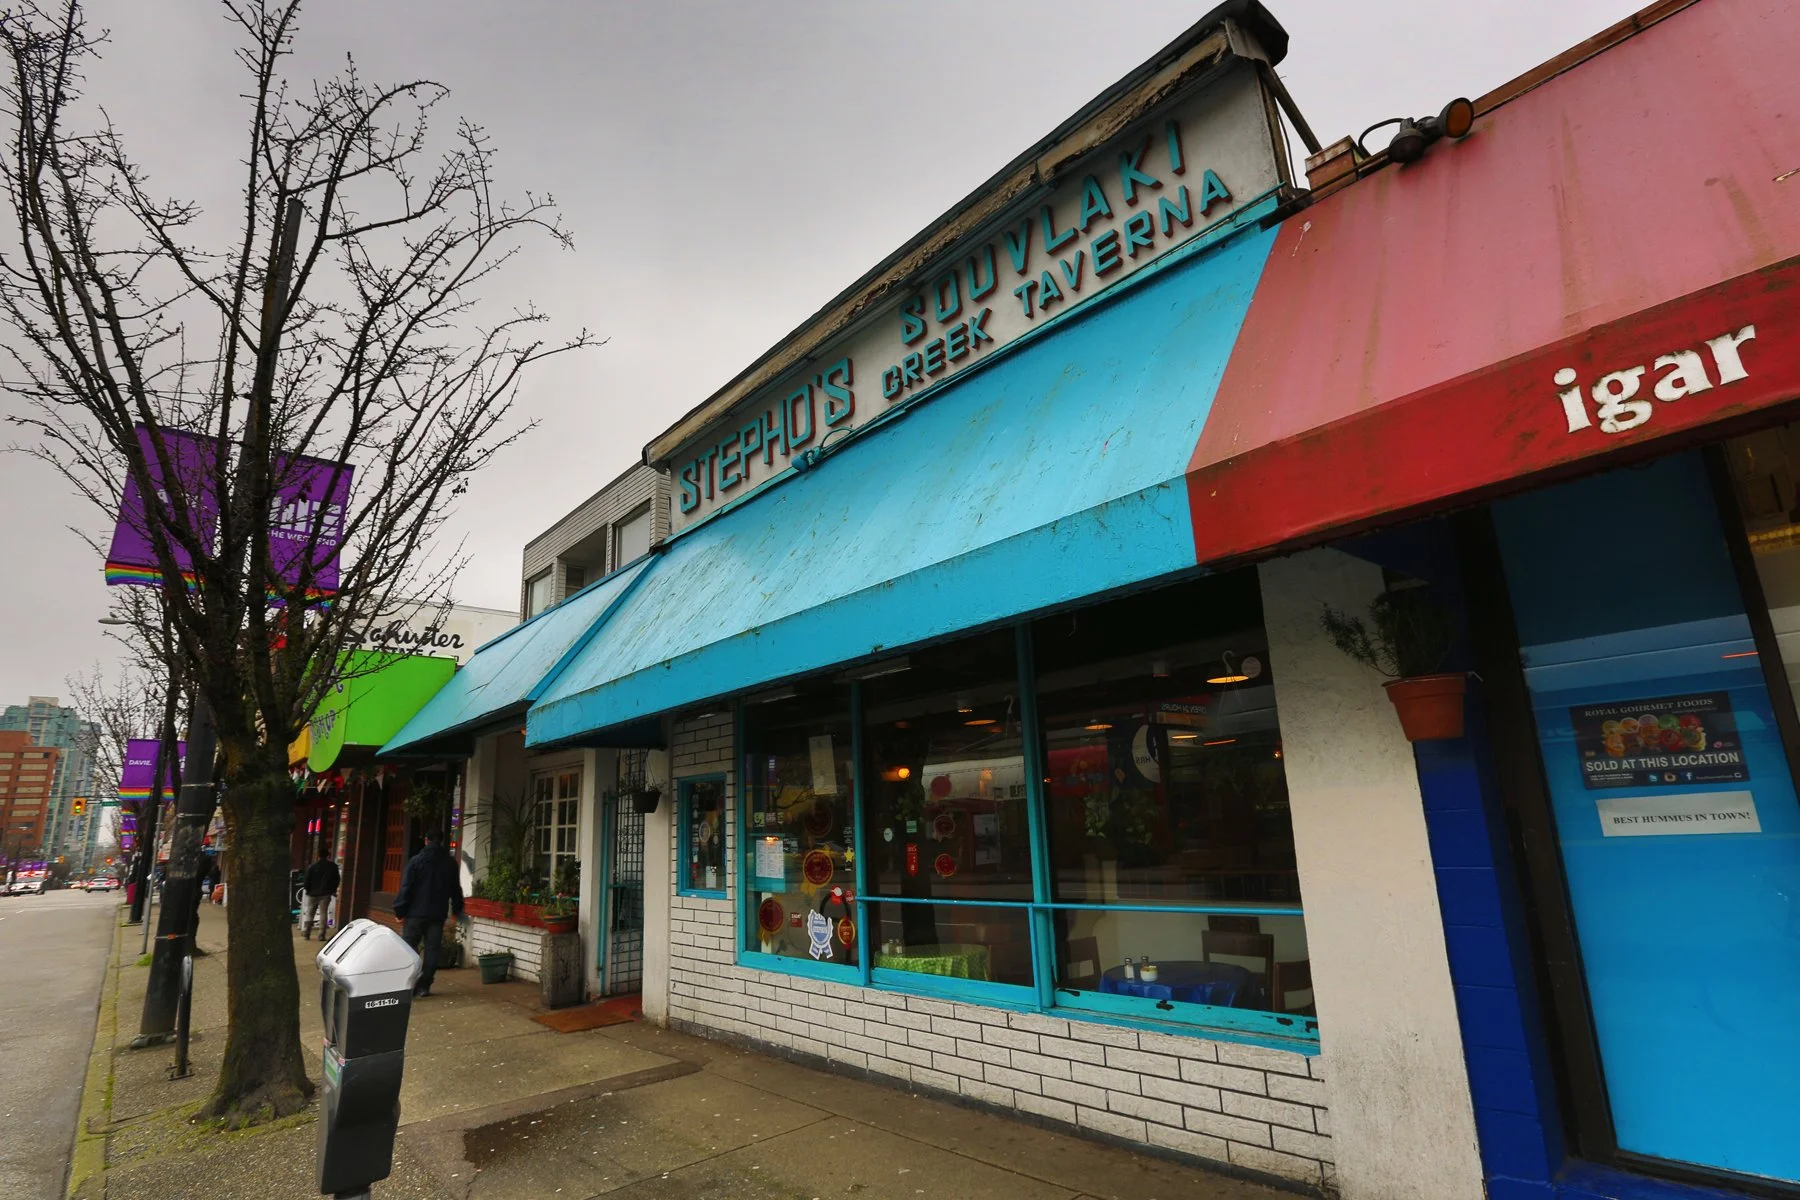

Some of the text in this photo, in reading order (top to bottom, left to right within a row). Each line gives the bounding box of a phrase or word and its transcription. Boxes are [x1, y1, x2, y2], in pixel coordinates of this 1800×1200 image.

[899, 119, 1187, 346] SOUVLAKI
[881, 167, 1233, 400] GREEK TAVERNA
[1553, 324, 1756, 434] igar
[678, 357, 857, 515] STEPHO'S
[268, 530, 286, 540] HE
[1584, 705, 1618, 717] ROYAL
[1620, 702, 1674, 714] GOURMET
[1677, 698, 1713, 707] FOODS
[1586, 752, 1740, 772] SOLD AT THIS LOCATION
[1613, 811, 1751, 824] BEST HUMMUS IN TOWN!
